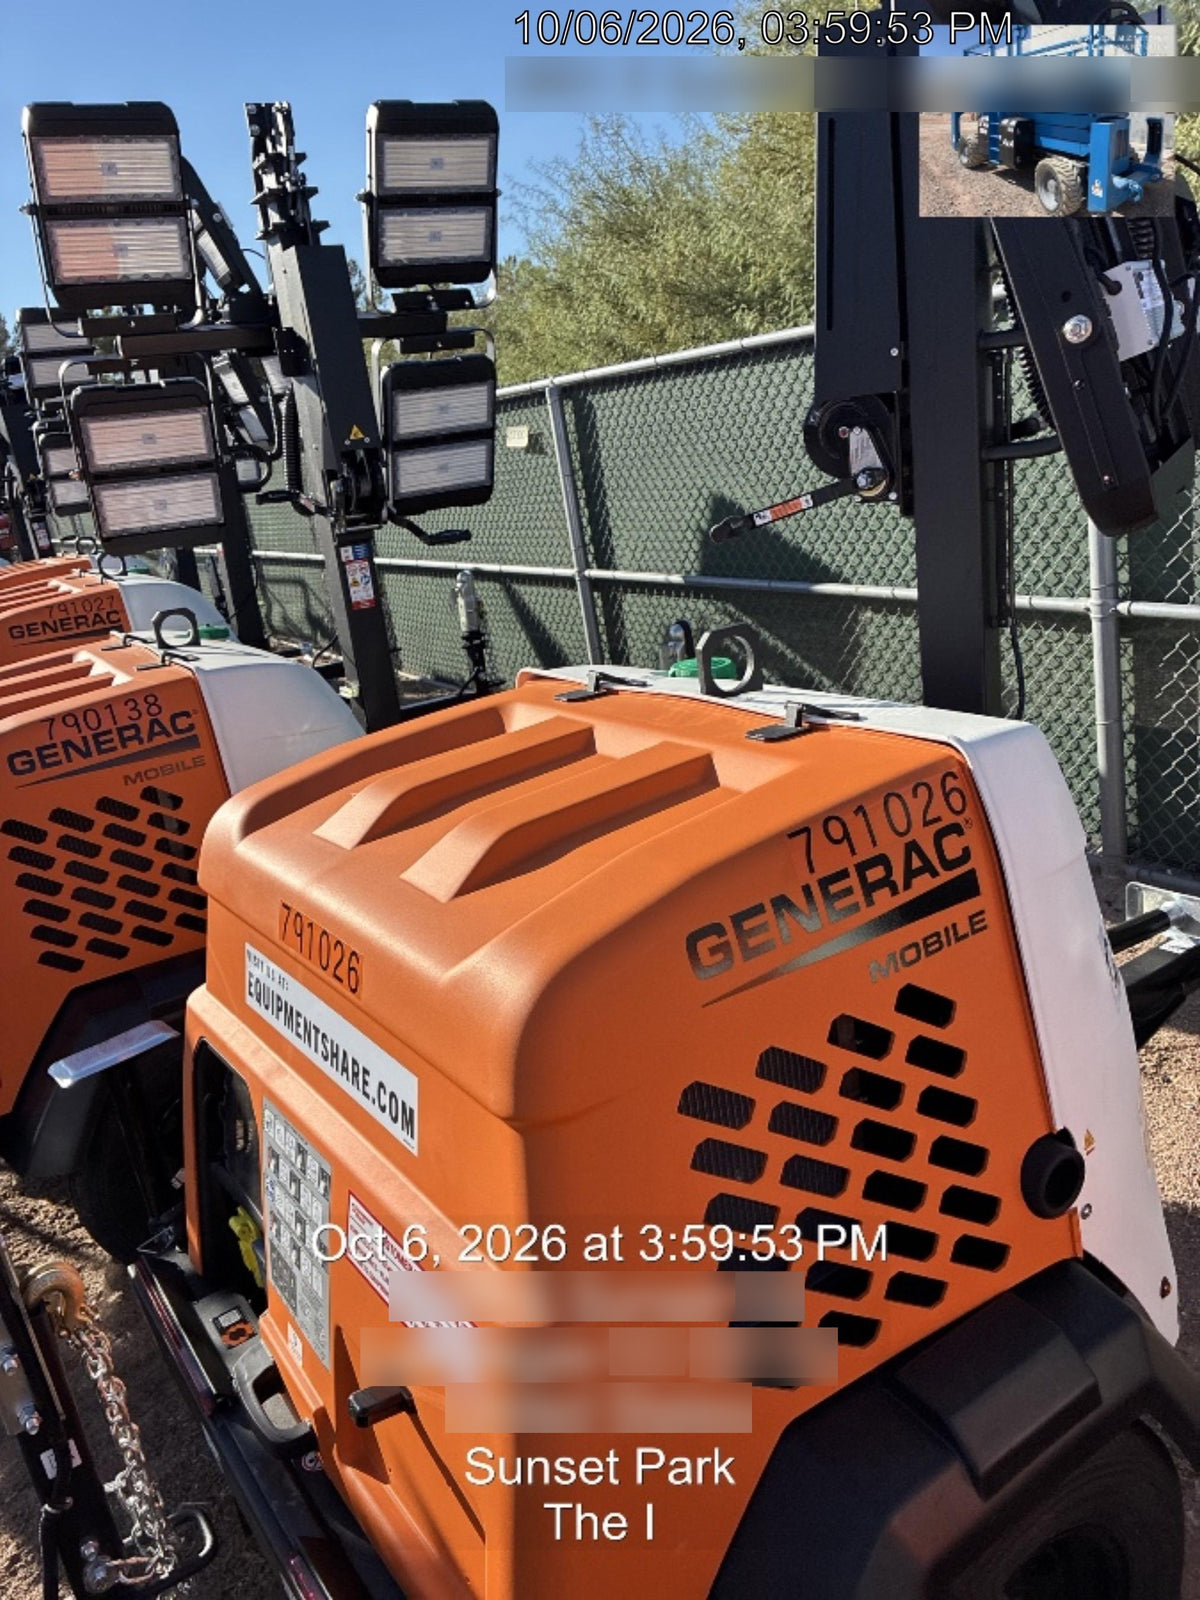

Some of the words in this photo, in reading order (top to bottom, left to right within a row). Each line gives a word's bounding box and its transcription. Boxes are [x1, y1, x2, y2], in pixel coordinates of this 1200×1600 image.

[9, 610, 121, 639] GENERAC
[47, 595, 115, 619] 791027
[8, 710, 196, 776] GENERAC
[43, 694, 163, 740] 790138
[123, 755, 207, 787] MOBILE
[787, 771, 968, 875] 791026
[686, 823, 970, 981] GENERAC
[281, 901, 361, 995] 791026
[869, 910, 989, 984] MOBILE
[248, 971, 416, 1141] EQUIPMENTSHARE.COM
